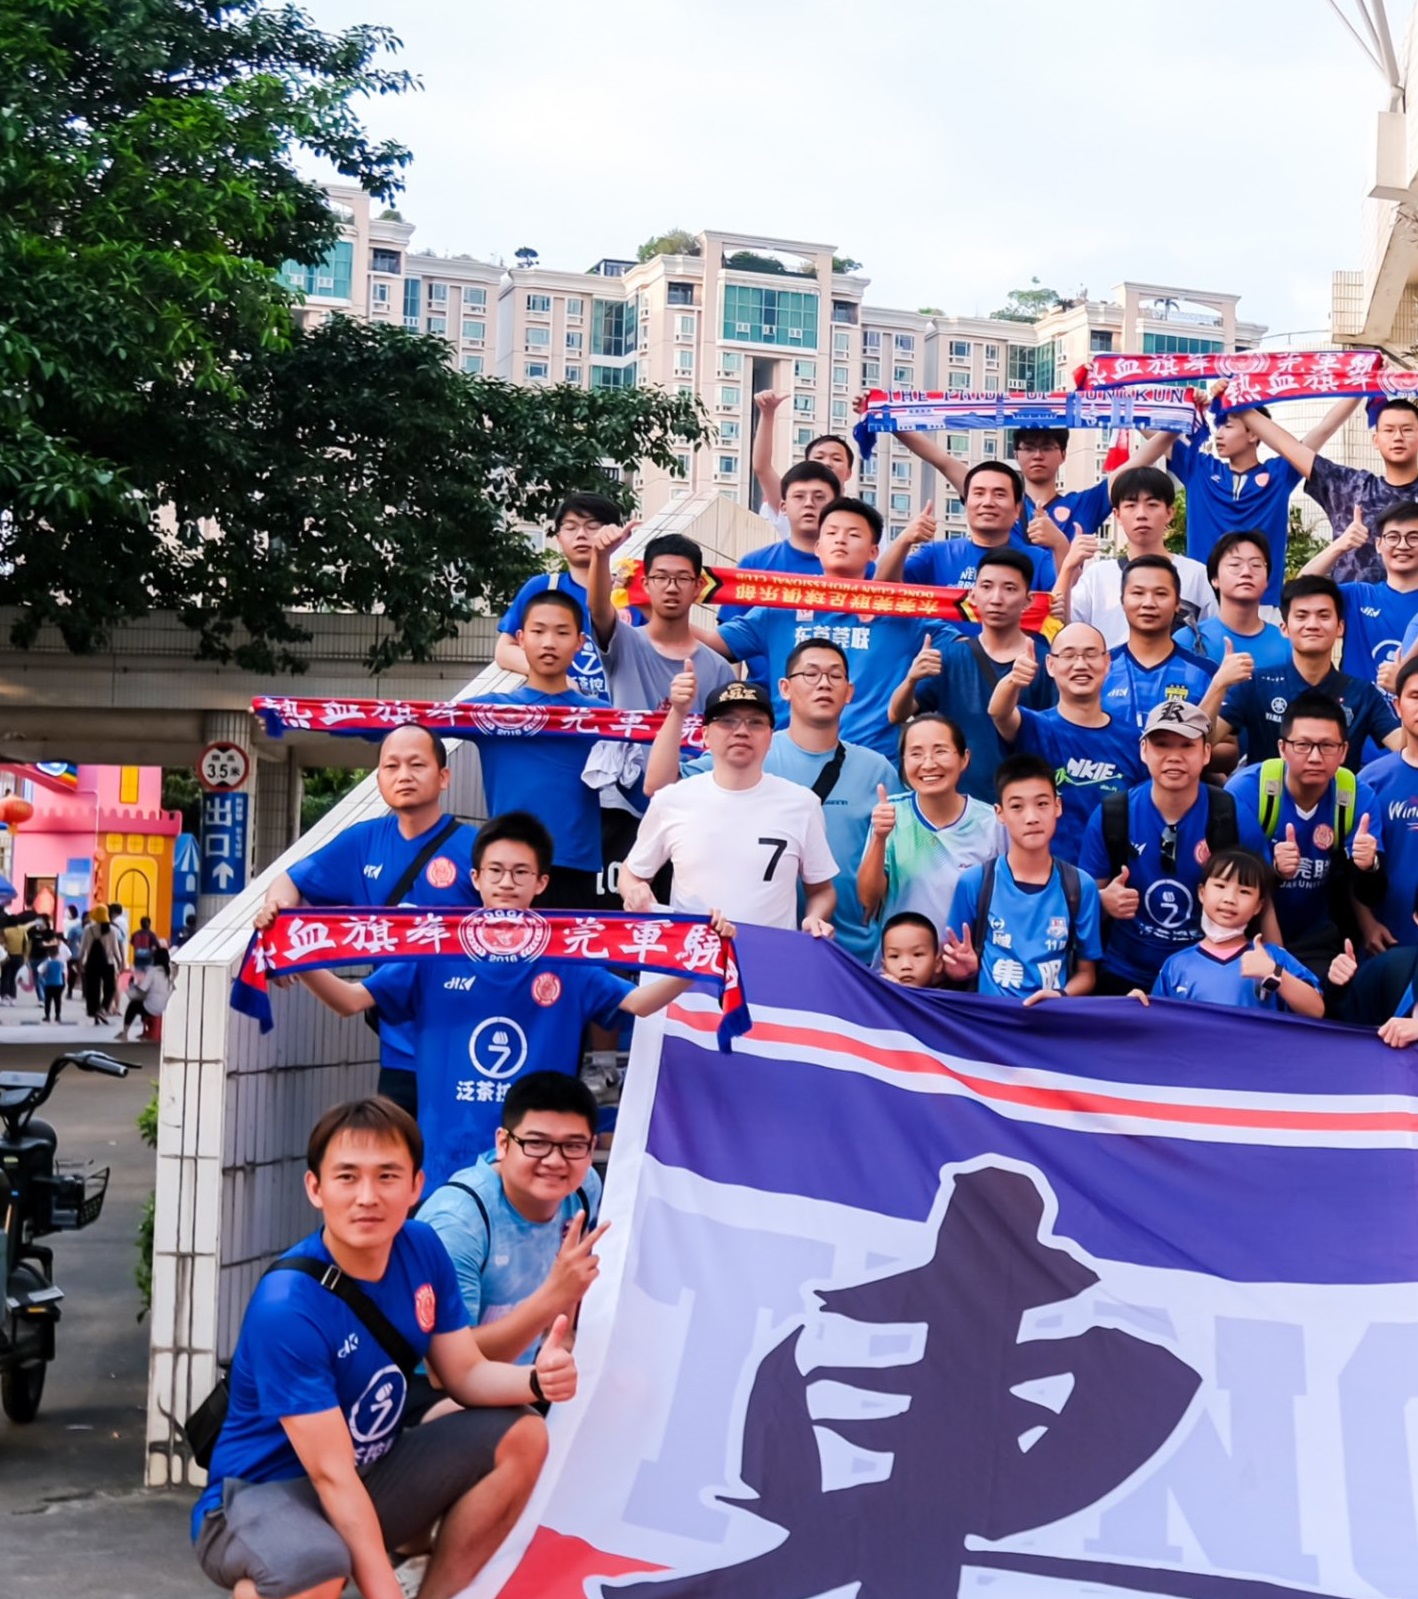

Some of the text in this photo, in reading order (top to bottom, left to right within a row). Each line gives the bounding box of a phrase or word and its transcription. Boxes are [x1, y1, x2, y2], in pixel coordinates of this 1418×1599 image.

[207, 764, 228, 778] 3.5
[206, 797, 232, 858] 出口
[758, 837, 788, 882] 7
